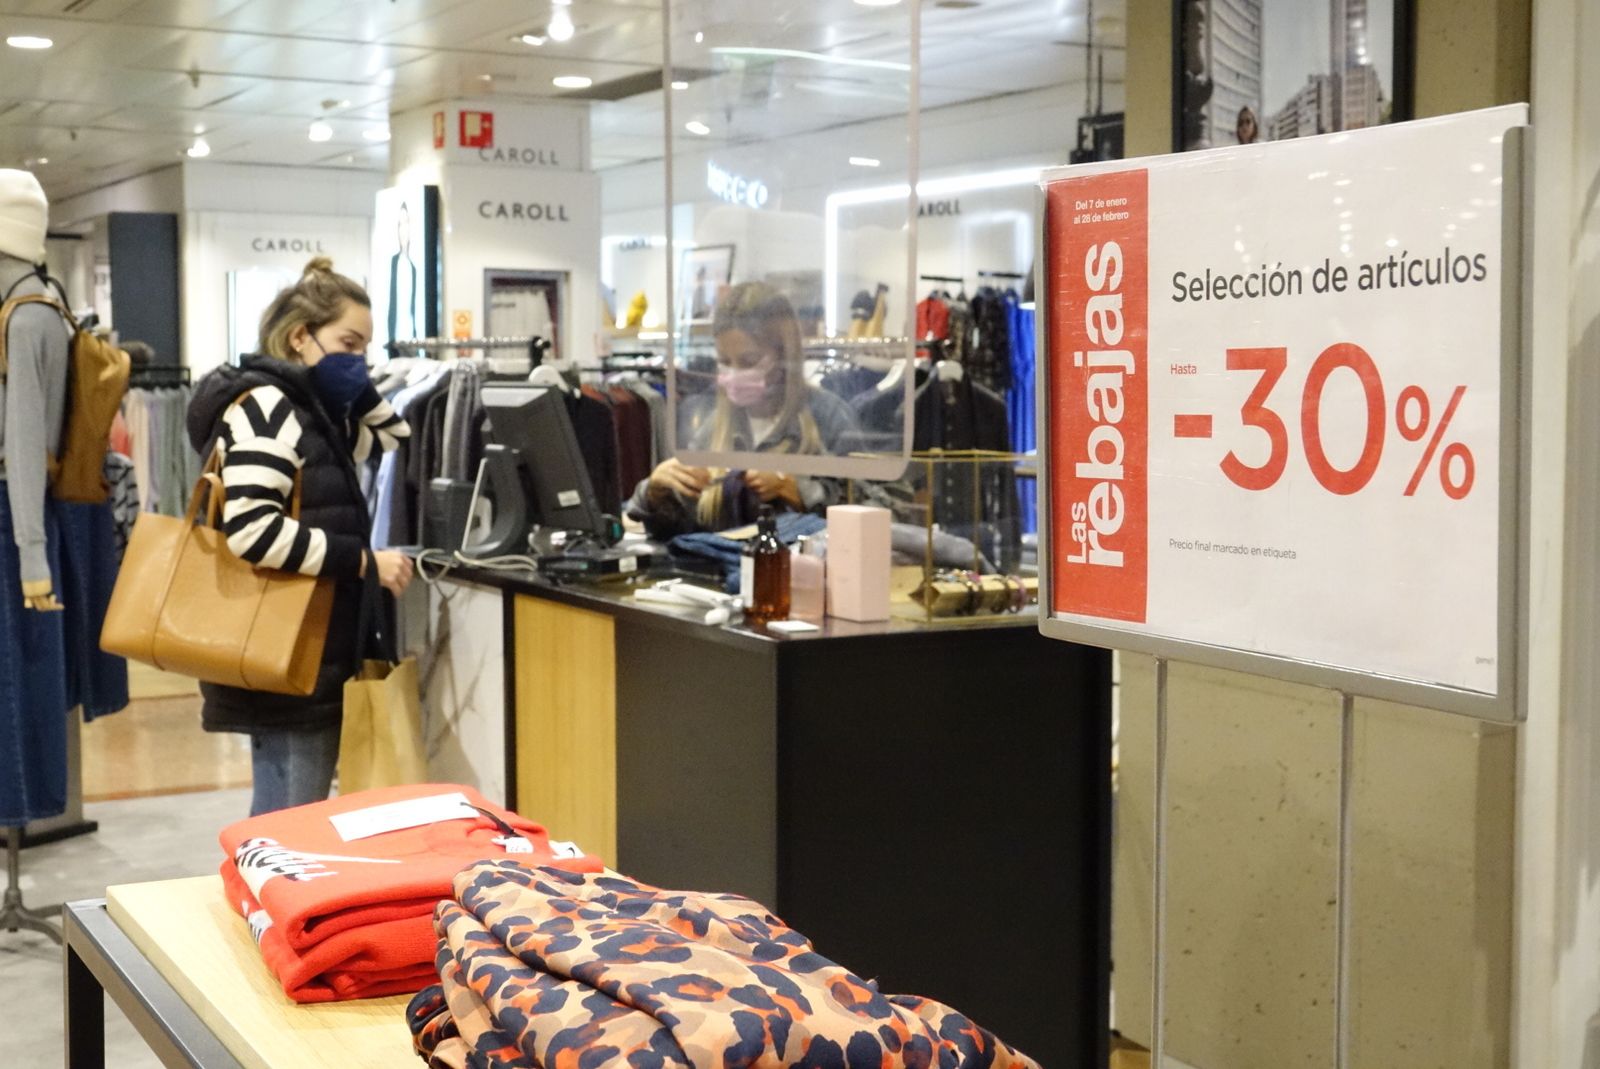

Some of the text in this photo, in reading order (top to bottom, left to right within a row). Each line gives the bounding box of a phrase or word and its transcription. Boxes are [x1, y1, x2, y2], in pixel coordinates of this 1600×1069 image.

[479, 146, 559, 165] CAROLL
[478, 200, 570, 221] CAROLL
[916, 198, 963, 217] AROLL
[1075, 197, 1127, 210] Del 7 de enero
[1073, 210, 1129, 225] al 28 de febrero
[251, 237, 323, 253] CAROLL
[1171, 246, 1488, 303] Selección de artículos
[1170, 363, 1198, 376] Hasta
[1074, 240, 1135, 567] rebajas
[1173, 342, 1476, 501] -30%
[1066, 501, 1088, 565] Las
[1169, 538, 1296, 559] Precio final marcado en etiqueta
